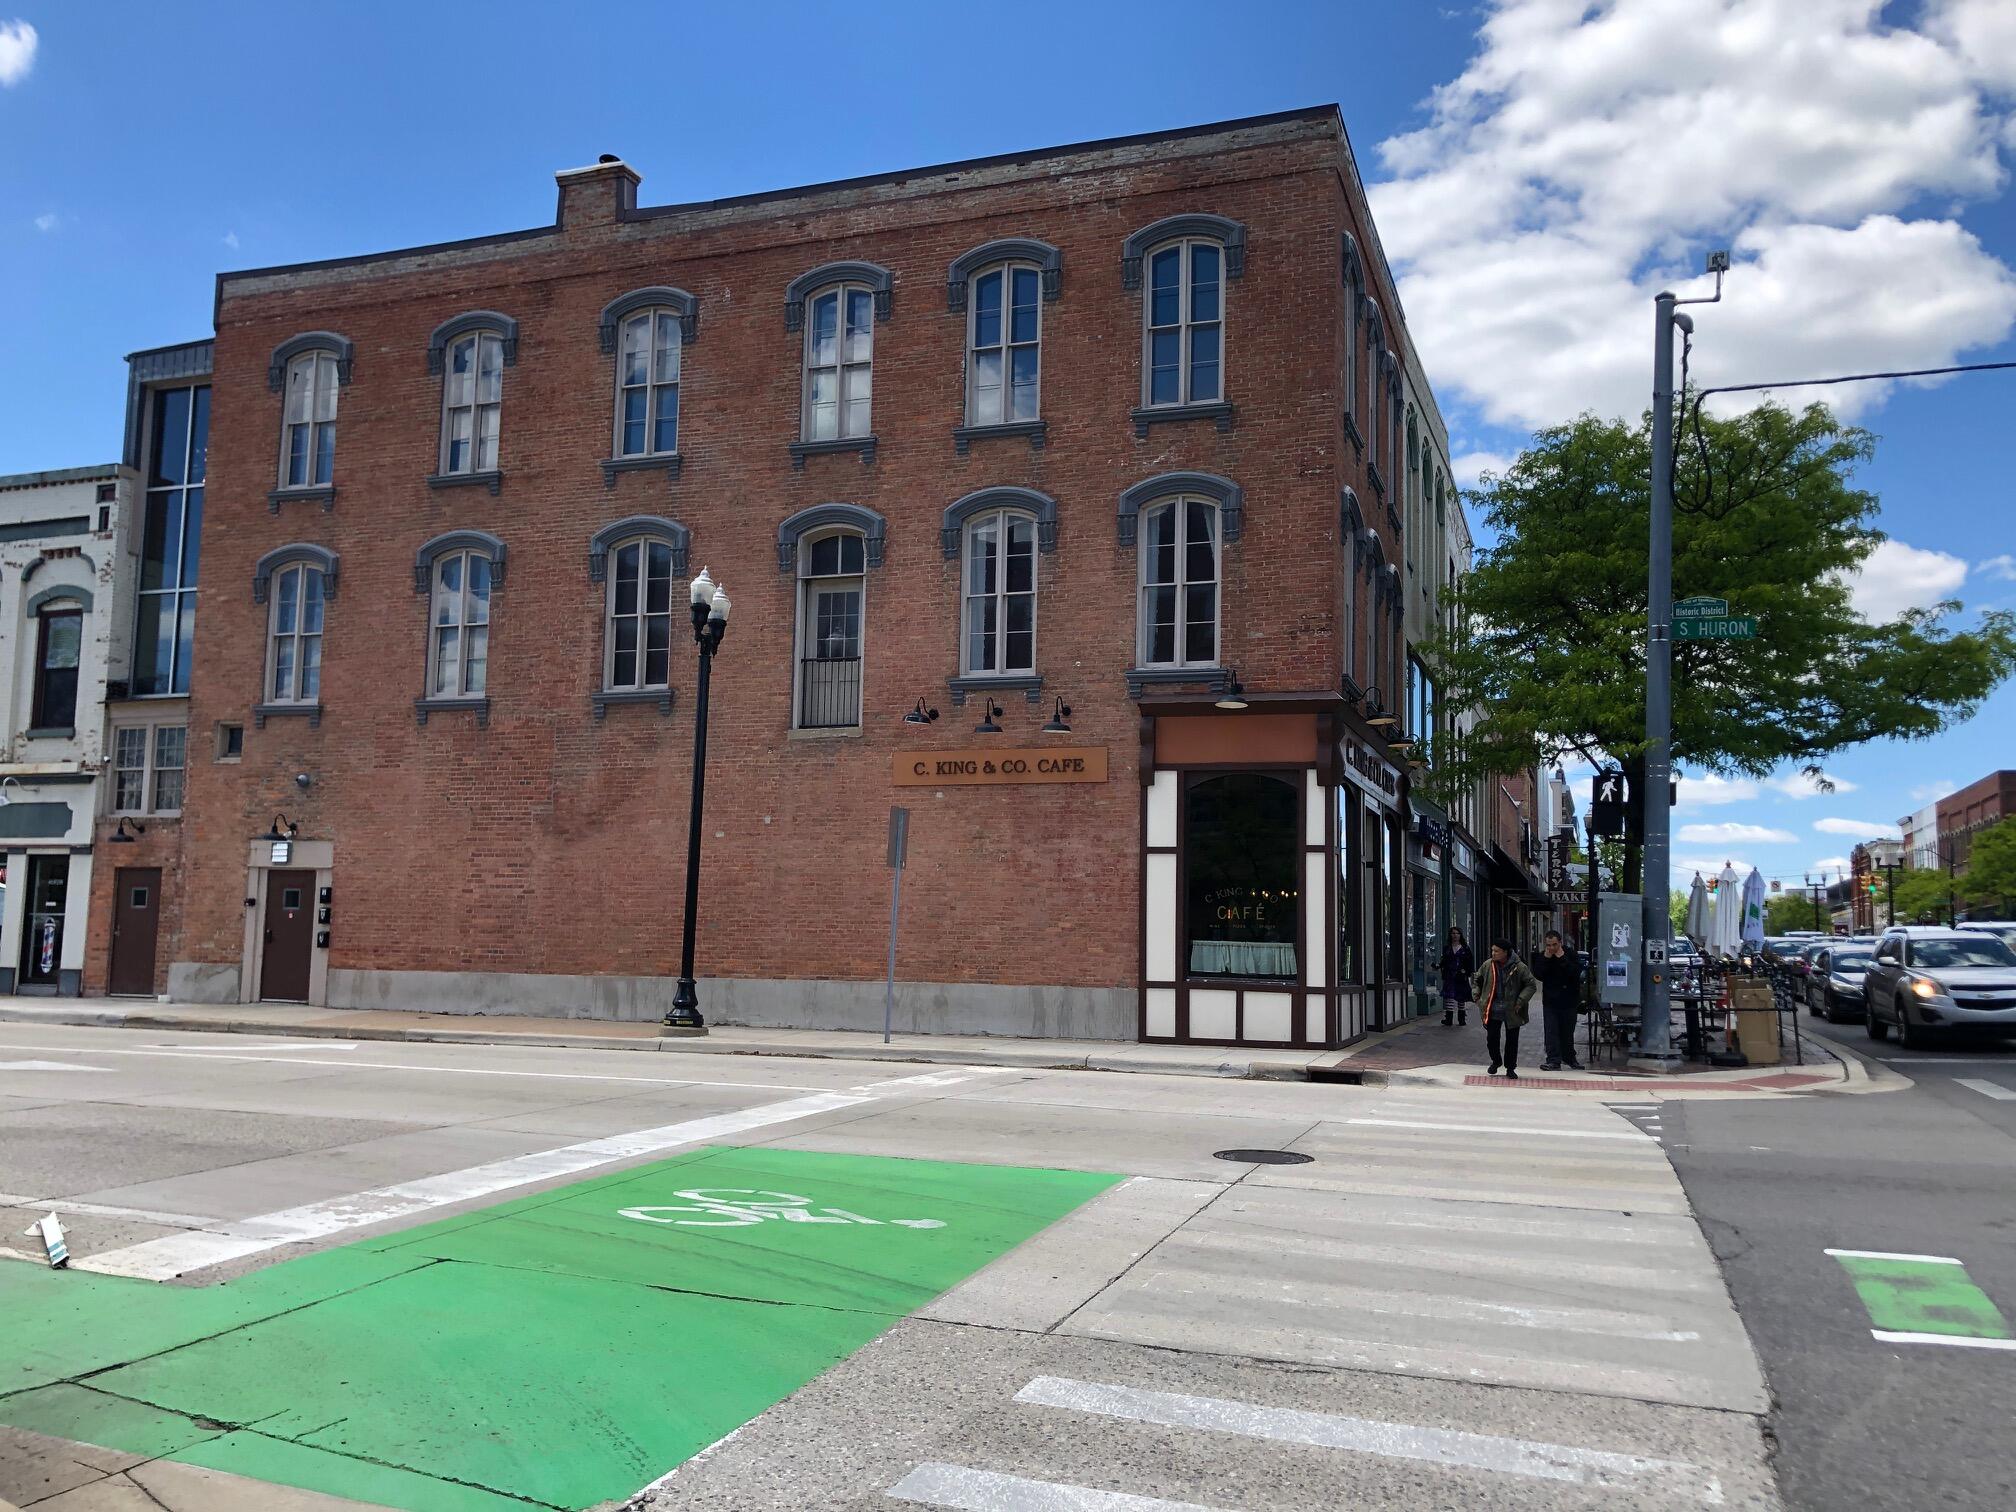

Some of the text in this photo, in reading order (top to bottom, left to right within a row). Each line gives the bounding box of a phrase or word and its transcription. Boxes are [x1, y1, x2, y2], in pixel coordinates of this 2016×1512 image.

[1675, 606, 1725, 616] Historic District
[1680, 621, 1748, 636] S HURON
[913, 758, 1084, 775] C. KING & CO. CAFE
[1216, 887, 1243, 899] KING
[1551, 893, 1589, 902] BAKE
[1217, 902, 1265, 920] CAFÉ
